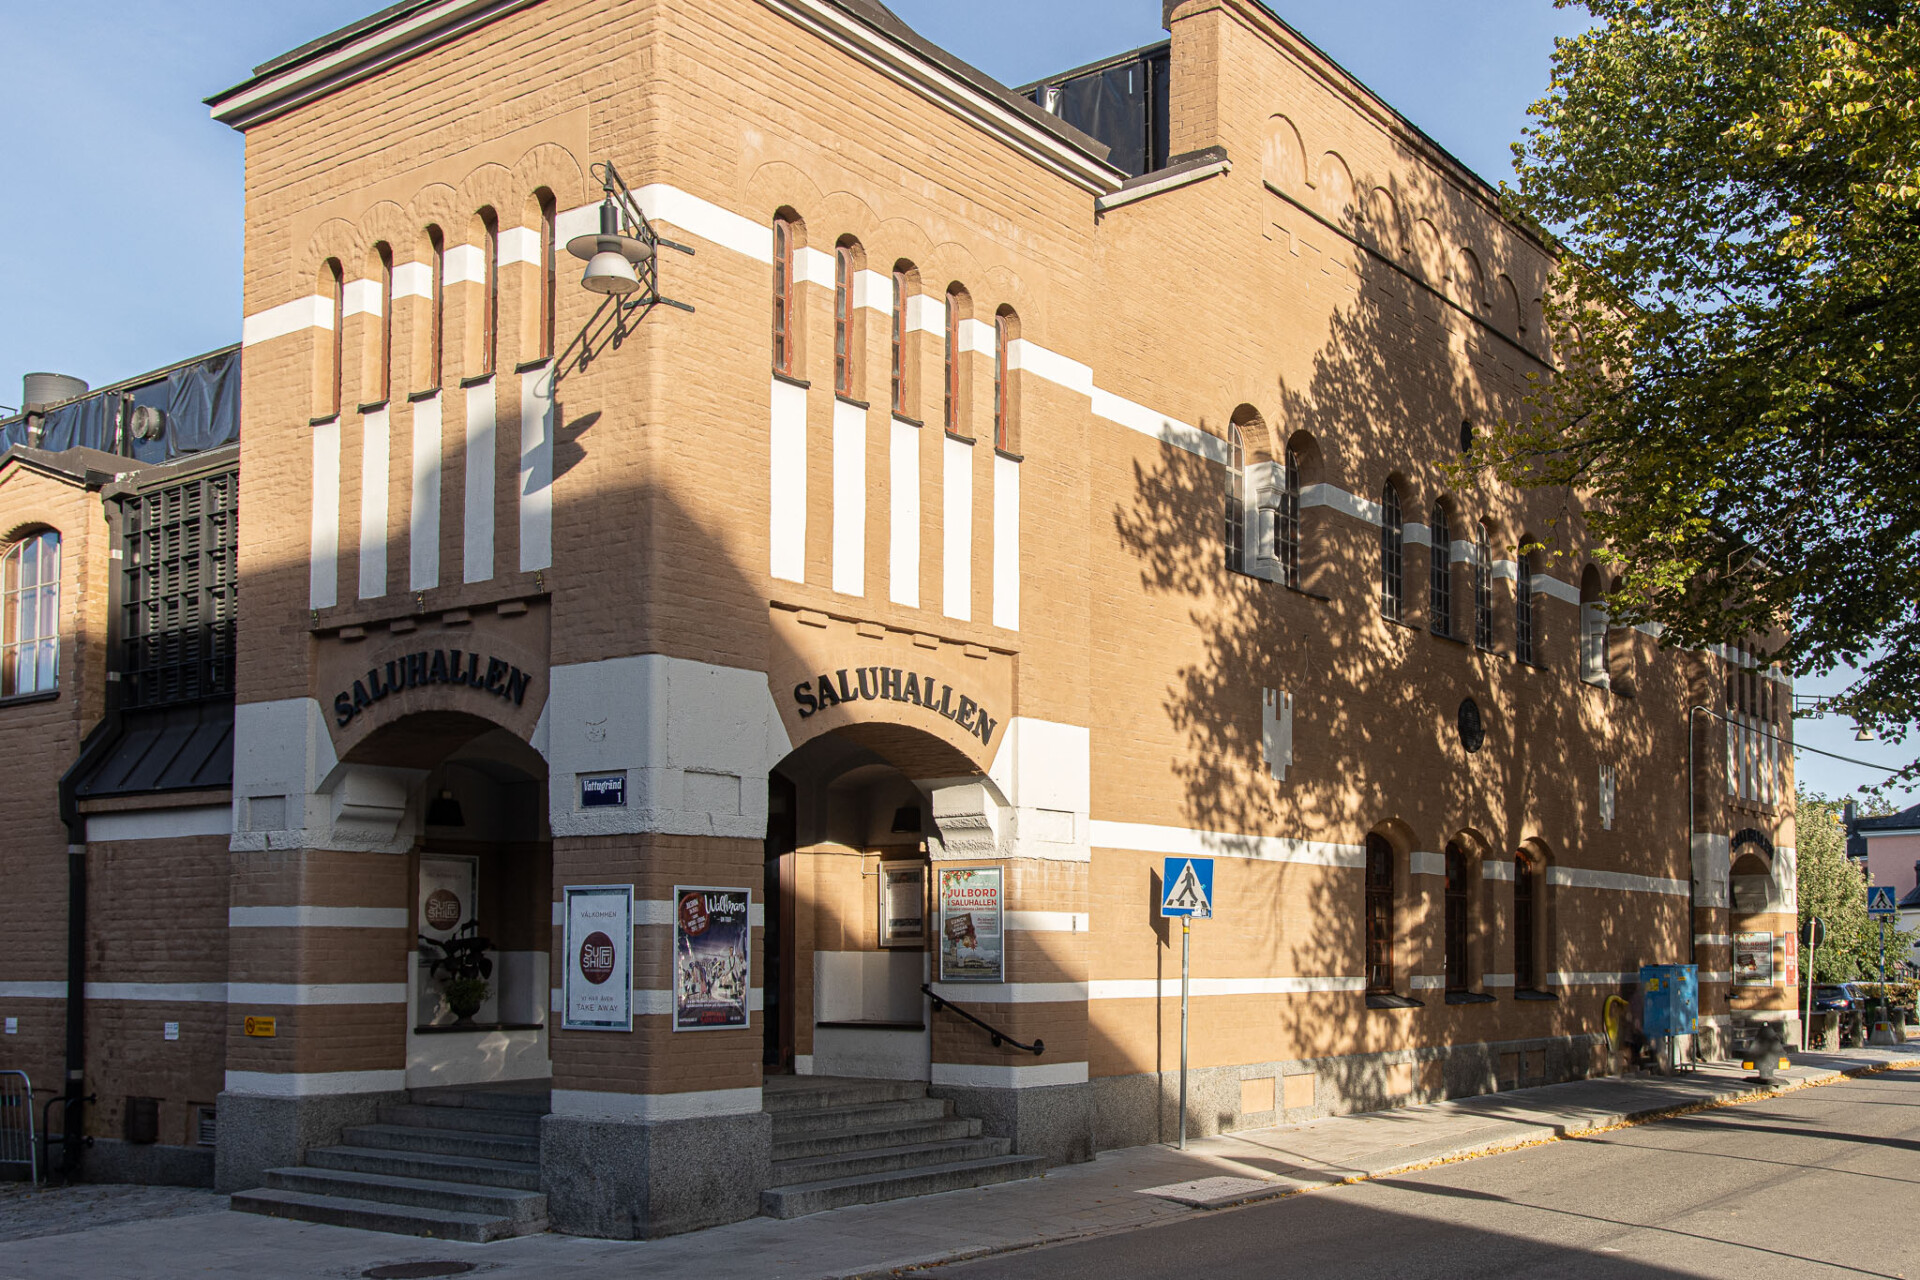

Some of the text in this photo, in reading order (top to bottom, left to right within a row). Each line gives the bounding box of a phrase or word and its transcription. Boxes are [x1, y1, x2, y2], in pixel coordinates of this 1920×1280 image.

[334, 649, 532, 727] SALUHALLEN
[794, 667, 998, 746] SALUHALLEN
[584, 778, 622, 794] Vattugränd
[617, 792, 621, 803] 1
[948, 889, 997, 898] JULBORD
[704, 894, 746, 914] Wallmans
[581, 910, 617, 918] VÄLKOMMEN
[584, 943, 600, 957] SU
[583, 957, 599, 968] SHI
[576, 1003, 618, 1011] TAKE AWAY
